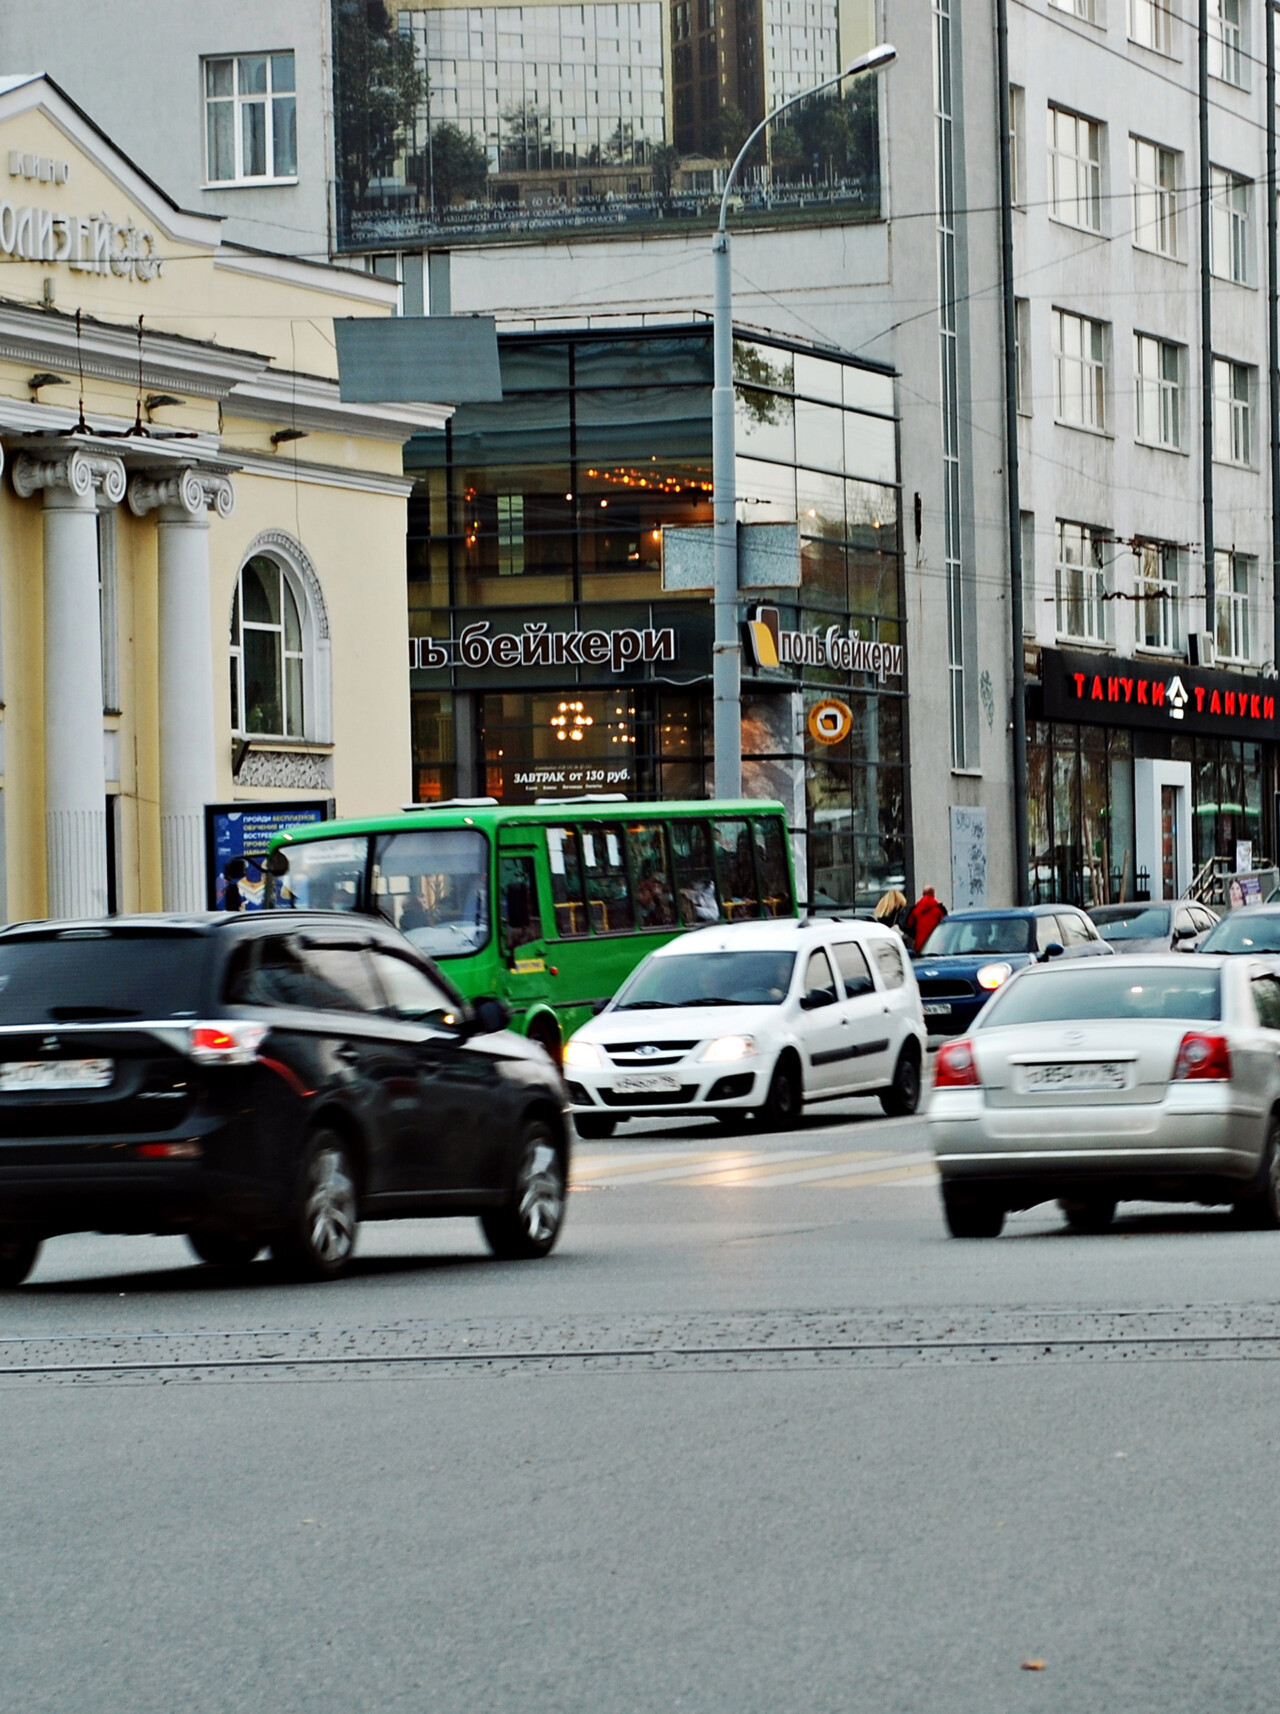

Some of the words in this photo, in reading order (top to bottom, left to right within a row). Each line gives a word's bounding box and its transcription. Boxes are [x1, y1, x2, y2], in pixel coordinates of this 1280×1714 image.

[9, 150, 70, 185] КИНО
[460, 622, 674, 672] бейкери
[780, 631, 826, 667] поль
[826, 625, 903, 684] бейкери
[1074, 673, 1164, 707] ТАНУКИ
[1194, 686, 1274, 720] ТАНУКИ
[513, 771, 565, 784] ЗАВТРАК
[569, 772, 583, 781] от
[586, 770, 605, 781] 130
[607, 768, 631, 783] руб.
[243, 815, 271, 823] ПРОЙДИ
[272, 813, 316, 822] БЕСПЛАТНОЕ
[243, 823, 278, 831] ОБУЧЕНИЕ
[243, 832, 275, 840] ВОСТРЕБ
